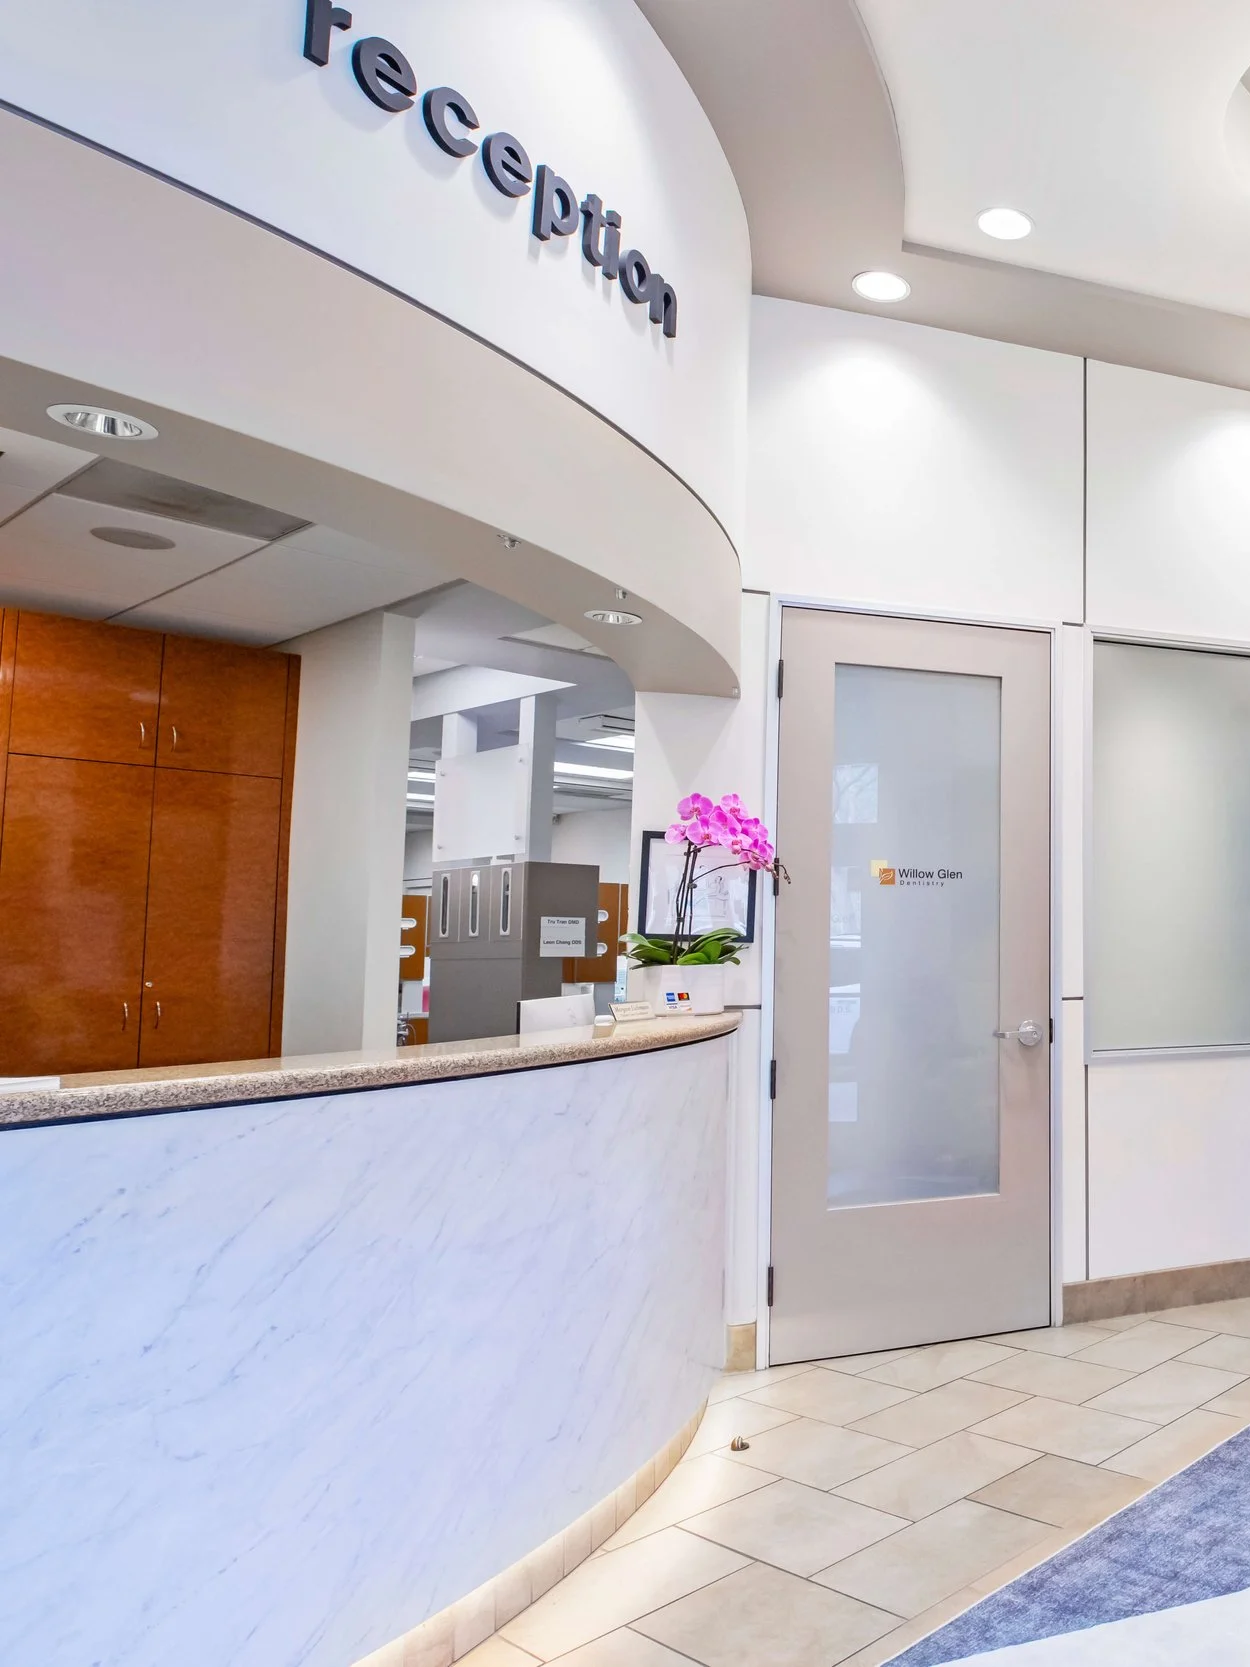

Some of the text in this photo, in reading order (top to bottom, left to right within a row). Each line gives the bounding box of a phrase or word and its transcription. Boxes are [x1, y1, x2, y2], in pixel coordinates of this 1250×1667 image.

[303, 0, 678, 338] reception
[898, 868, 963, 879] Willow Glen
